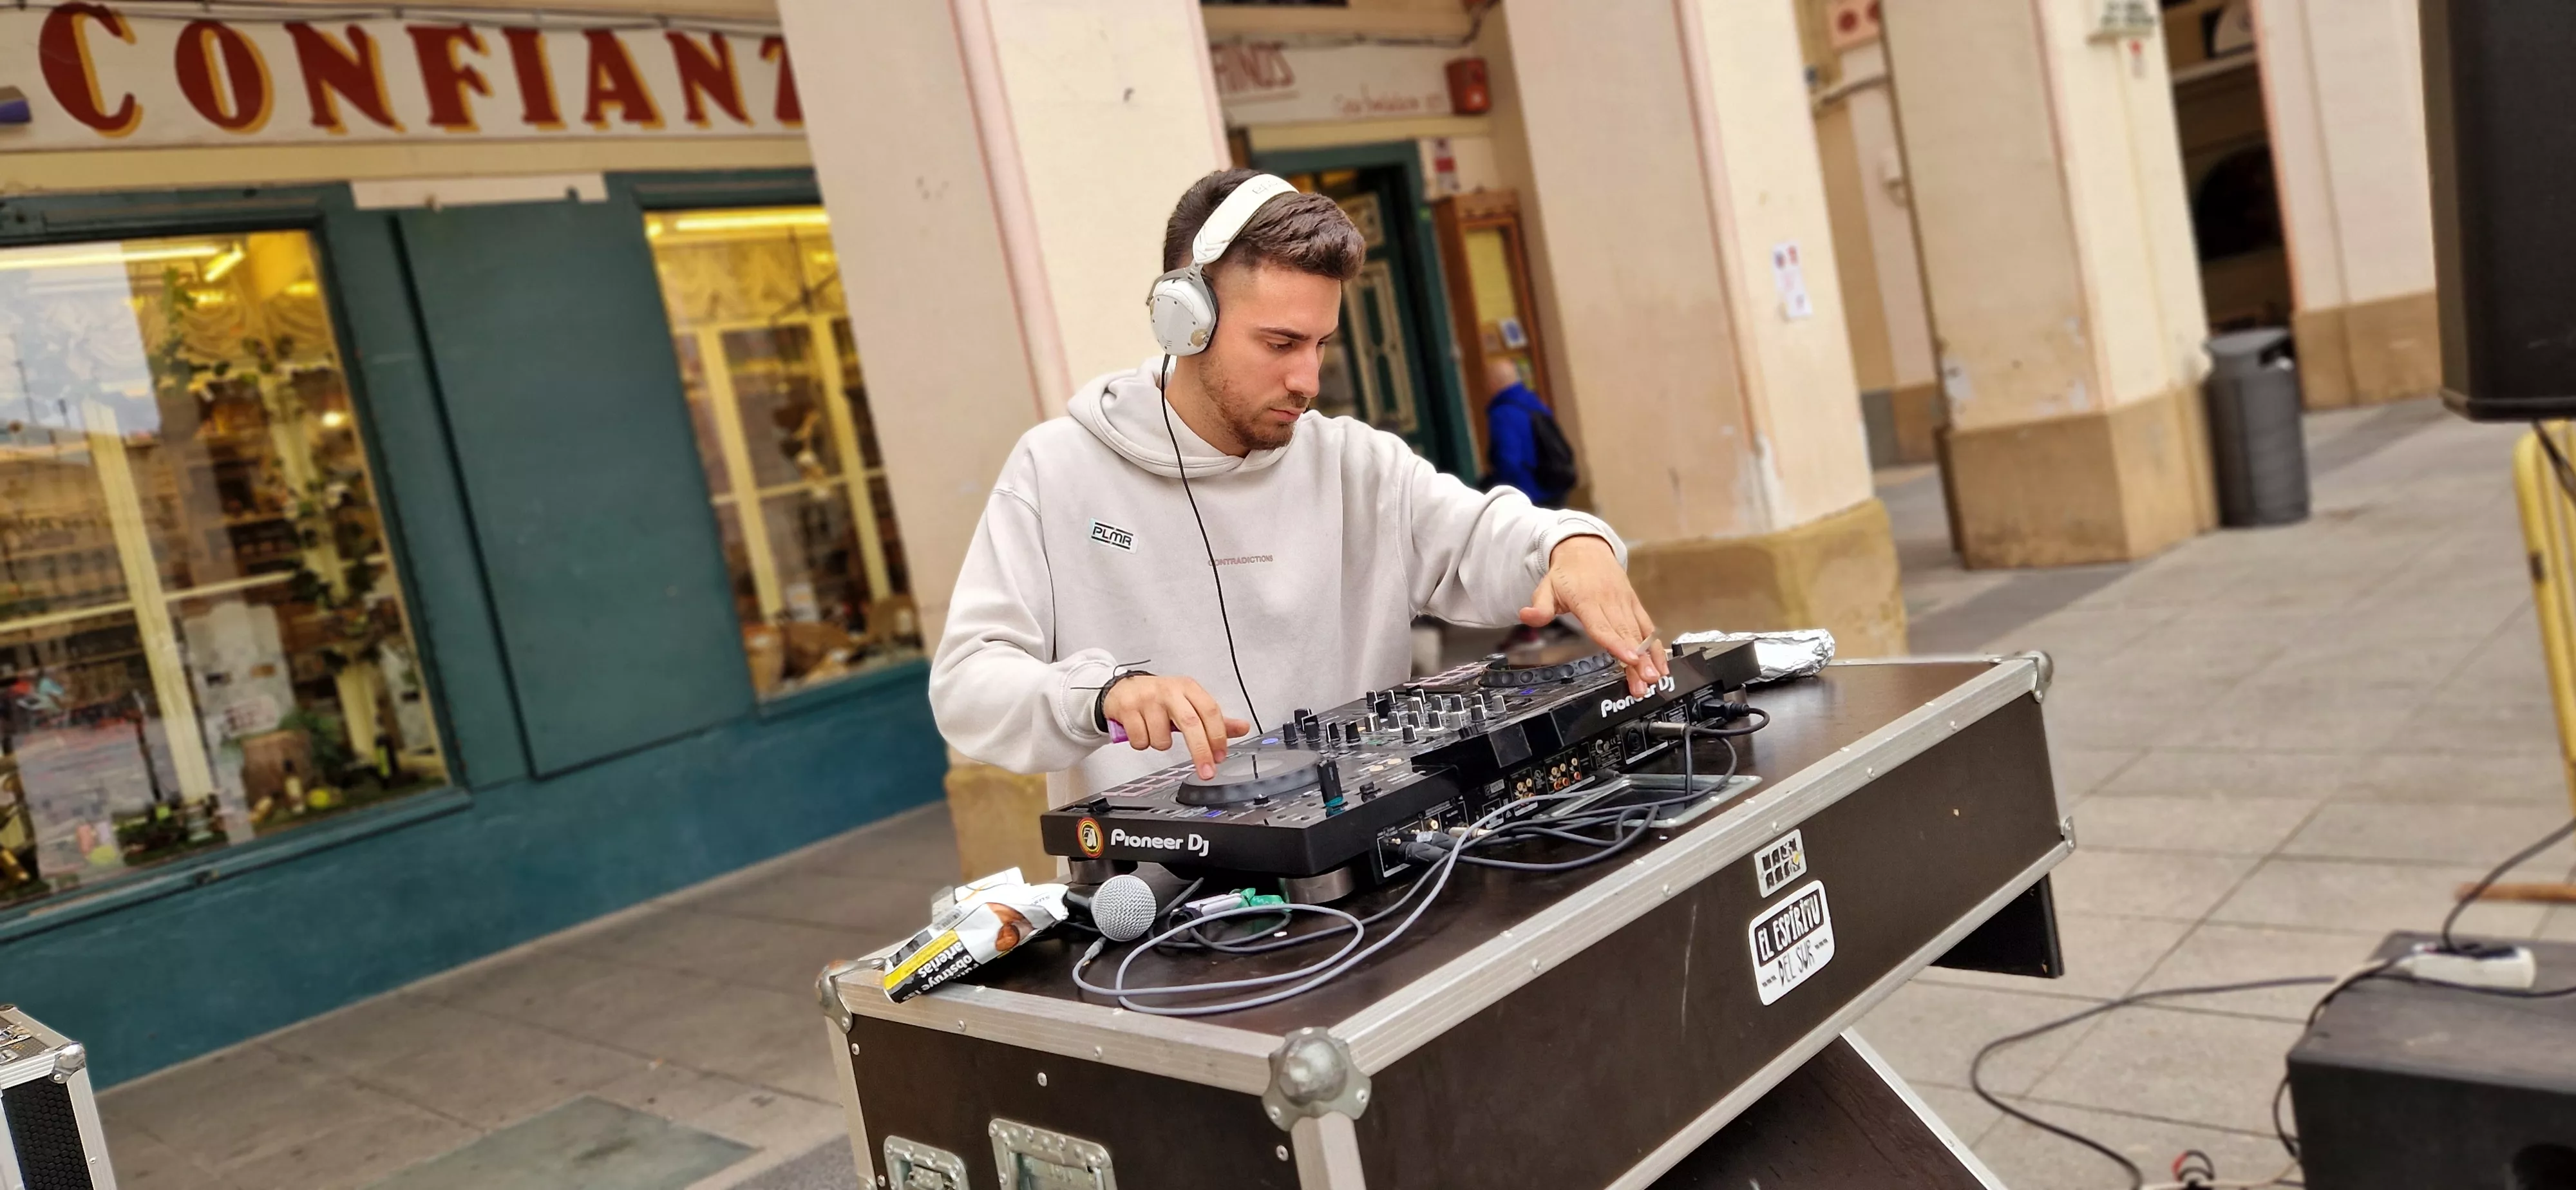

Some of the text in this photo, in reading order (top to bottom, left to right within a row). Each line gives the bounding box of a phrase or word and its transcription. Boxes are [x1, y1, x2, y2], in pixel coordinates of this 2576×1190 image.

[1093, 525, 1132, 546] PLMR
[1208, 554, 1274, 566] CONTRADICTIONS
[1111, 828, 1184, 850] Pioneer
[918, 941, 965, 978] arterias
[1757, 927, 1775, 961] EL
[921, 954, 972, 991] obstruye
[1777, 940, 1815, 987] DEL SUR
